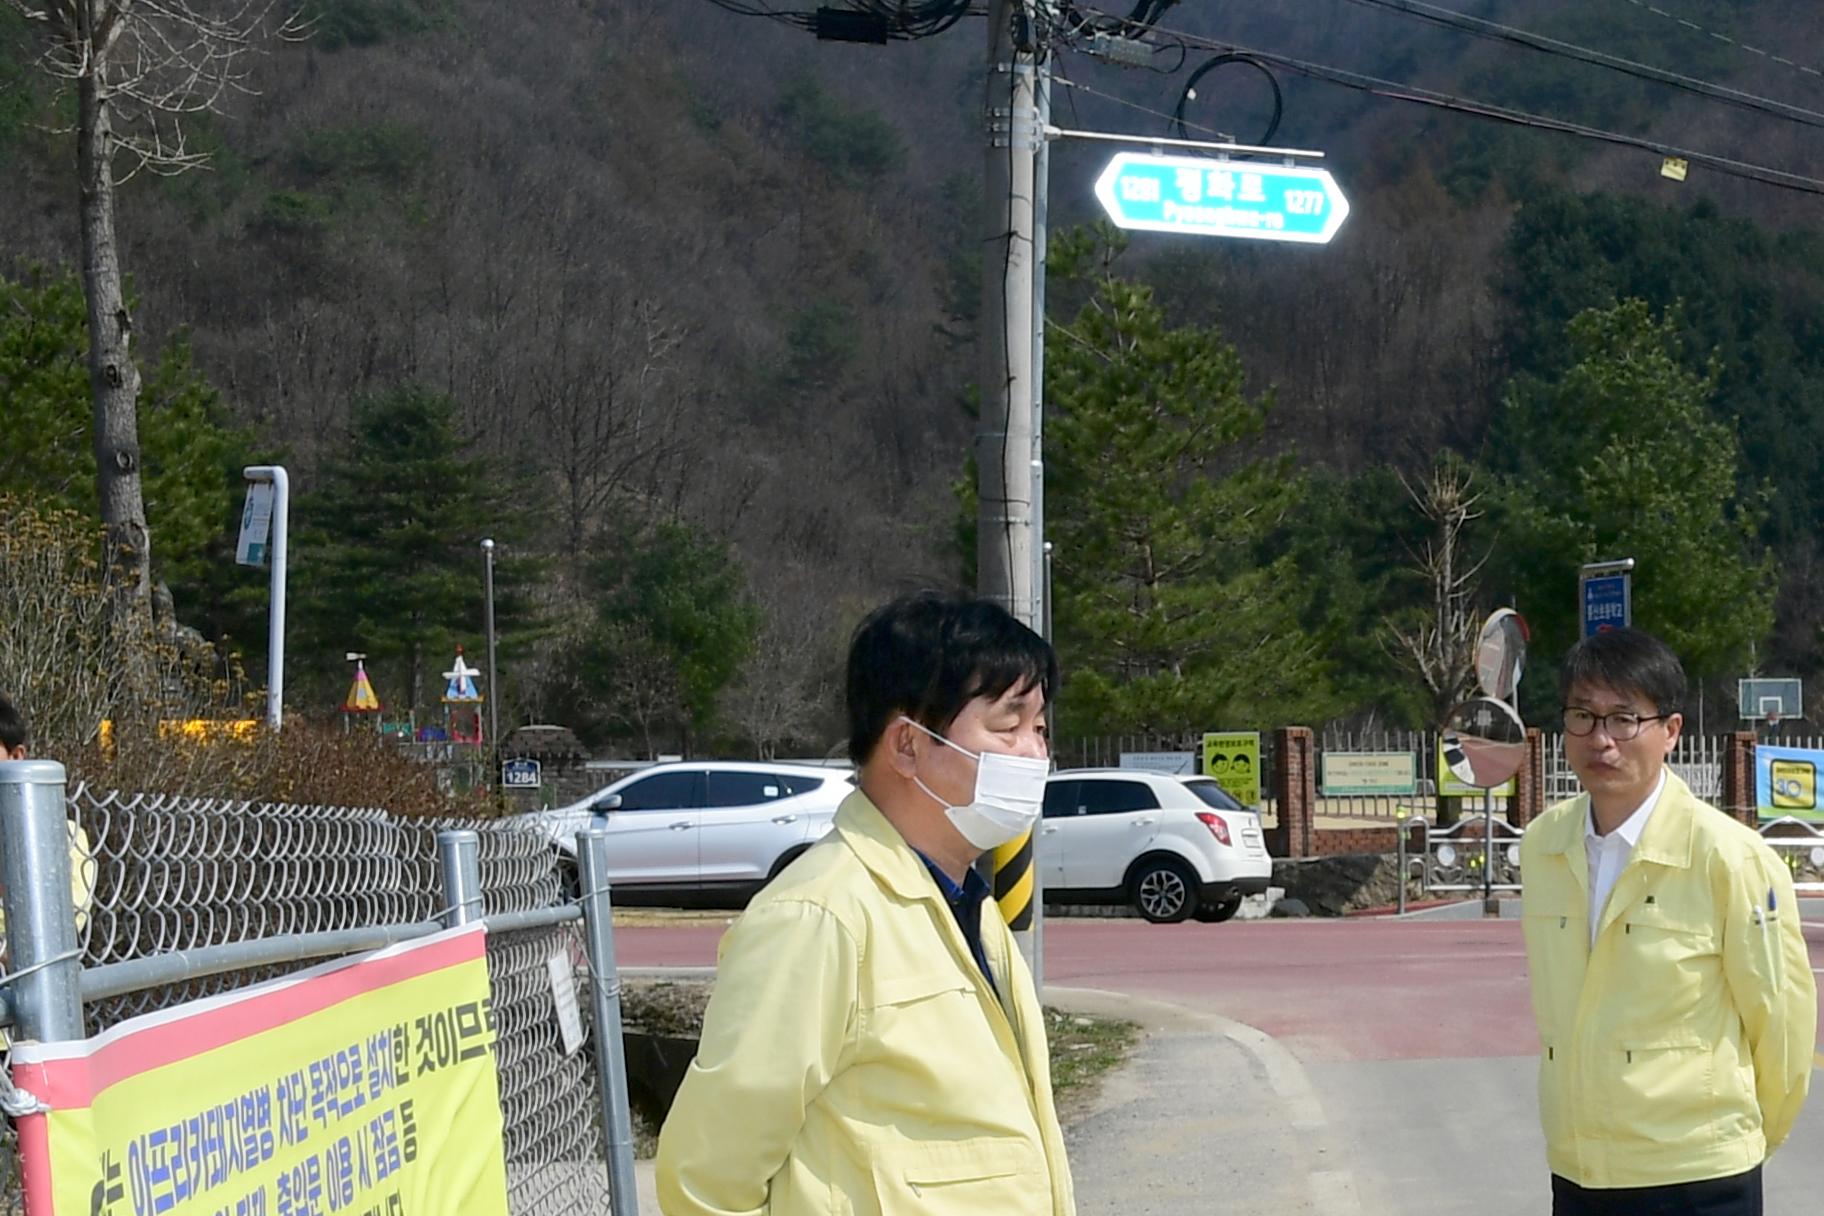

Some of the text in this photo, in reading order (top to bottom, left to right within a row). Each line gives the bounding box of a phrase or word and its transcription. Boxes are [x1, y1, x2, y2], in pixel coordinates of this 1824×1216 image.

[1285, 189, 1324, 215] 1277
[506, 771, 537, 784] 1284
[1775, 777, 1802, 798] 30
[277, 1068, 308, 1149] 차단
[308, 1044, 366, 1129] 목적으로
[366, 1022, 411, 1100] 설치한
[325, 1136, 354, 1212] 이용
[356, 1125, 372, 1191] 시
[370, 1109, 401, 1182] 잠금
[399, 1099, 417, 1163] 등
